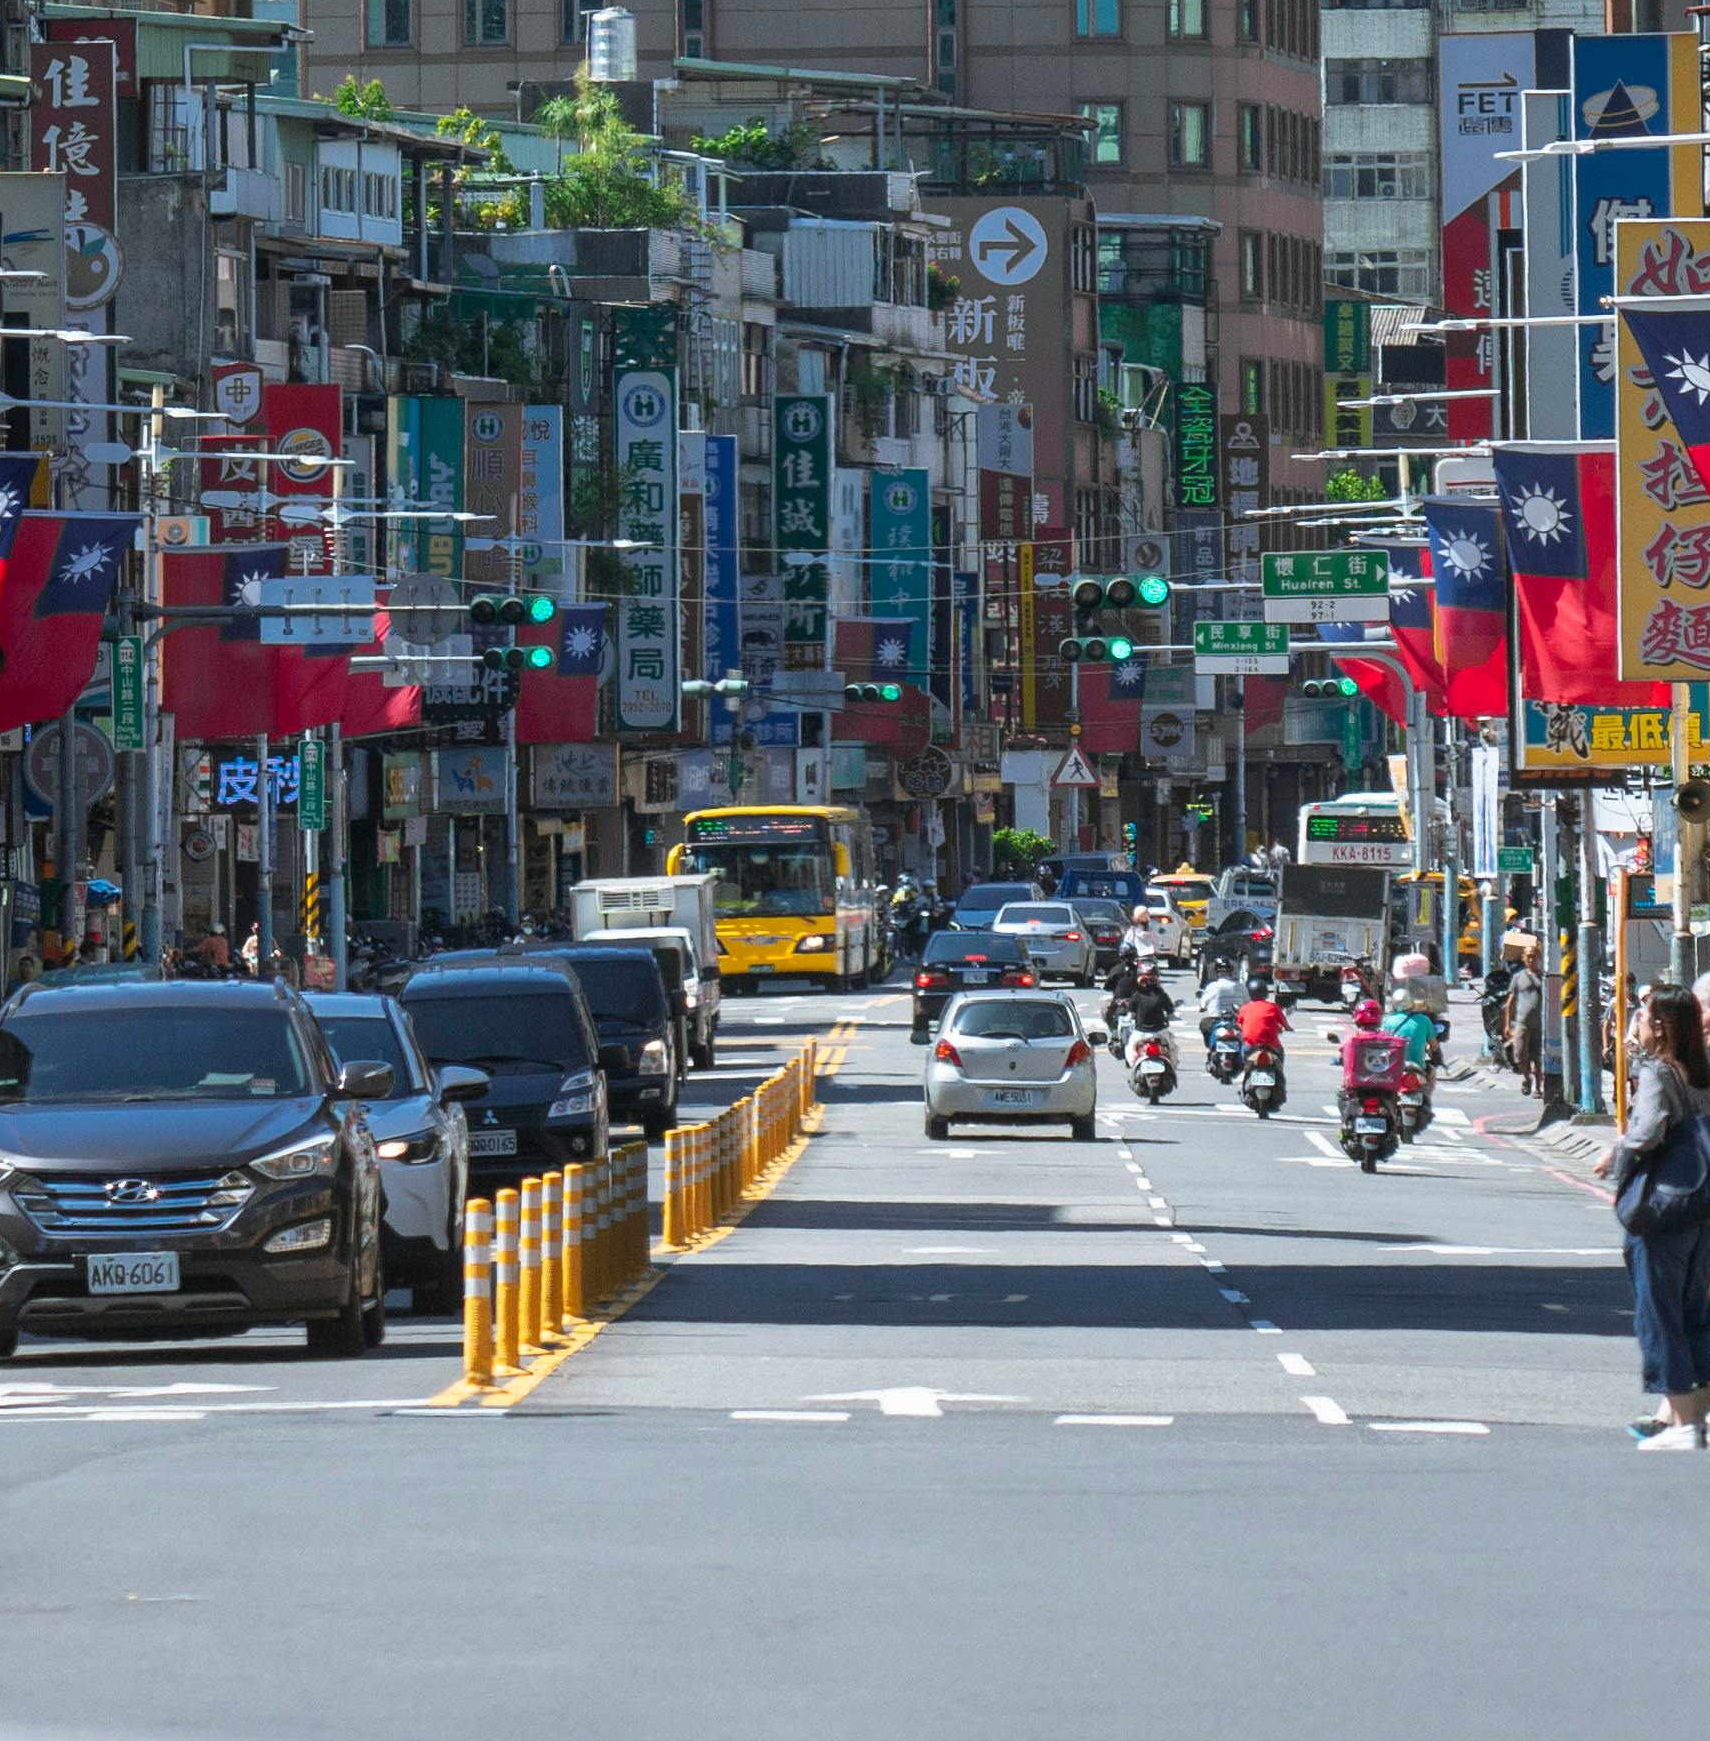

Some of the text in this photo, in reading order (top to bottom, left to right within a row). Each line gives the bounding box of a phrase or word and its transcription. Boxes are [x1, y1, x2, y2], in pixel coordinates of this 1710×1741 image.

[1458, 92, 1517, 114] FET
[1179, 385, 1215, 503] 全瓷牙冠
[428, 452, 455, 576] UBWAY
[627, 439, 665, 680] 廣和藥師藥局
[1275, 557, 1367, 576] 懷仁街
[1281, 579, 1361, 591] Huairen St.
[1310, 601, 1336, 609] 92-2
[1209, 625, 1281, 641] 民享街
[122, 664, 135, 726] 中山路二段
[1332, 846, 1392, 861] KKA-8115
